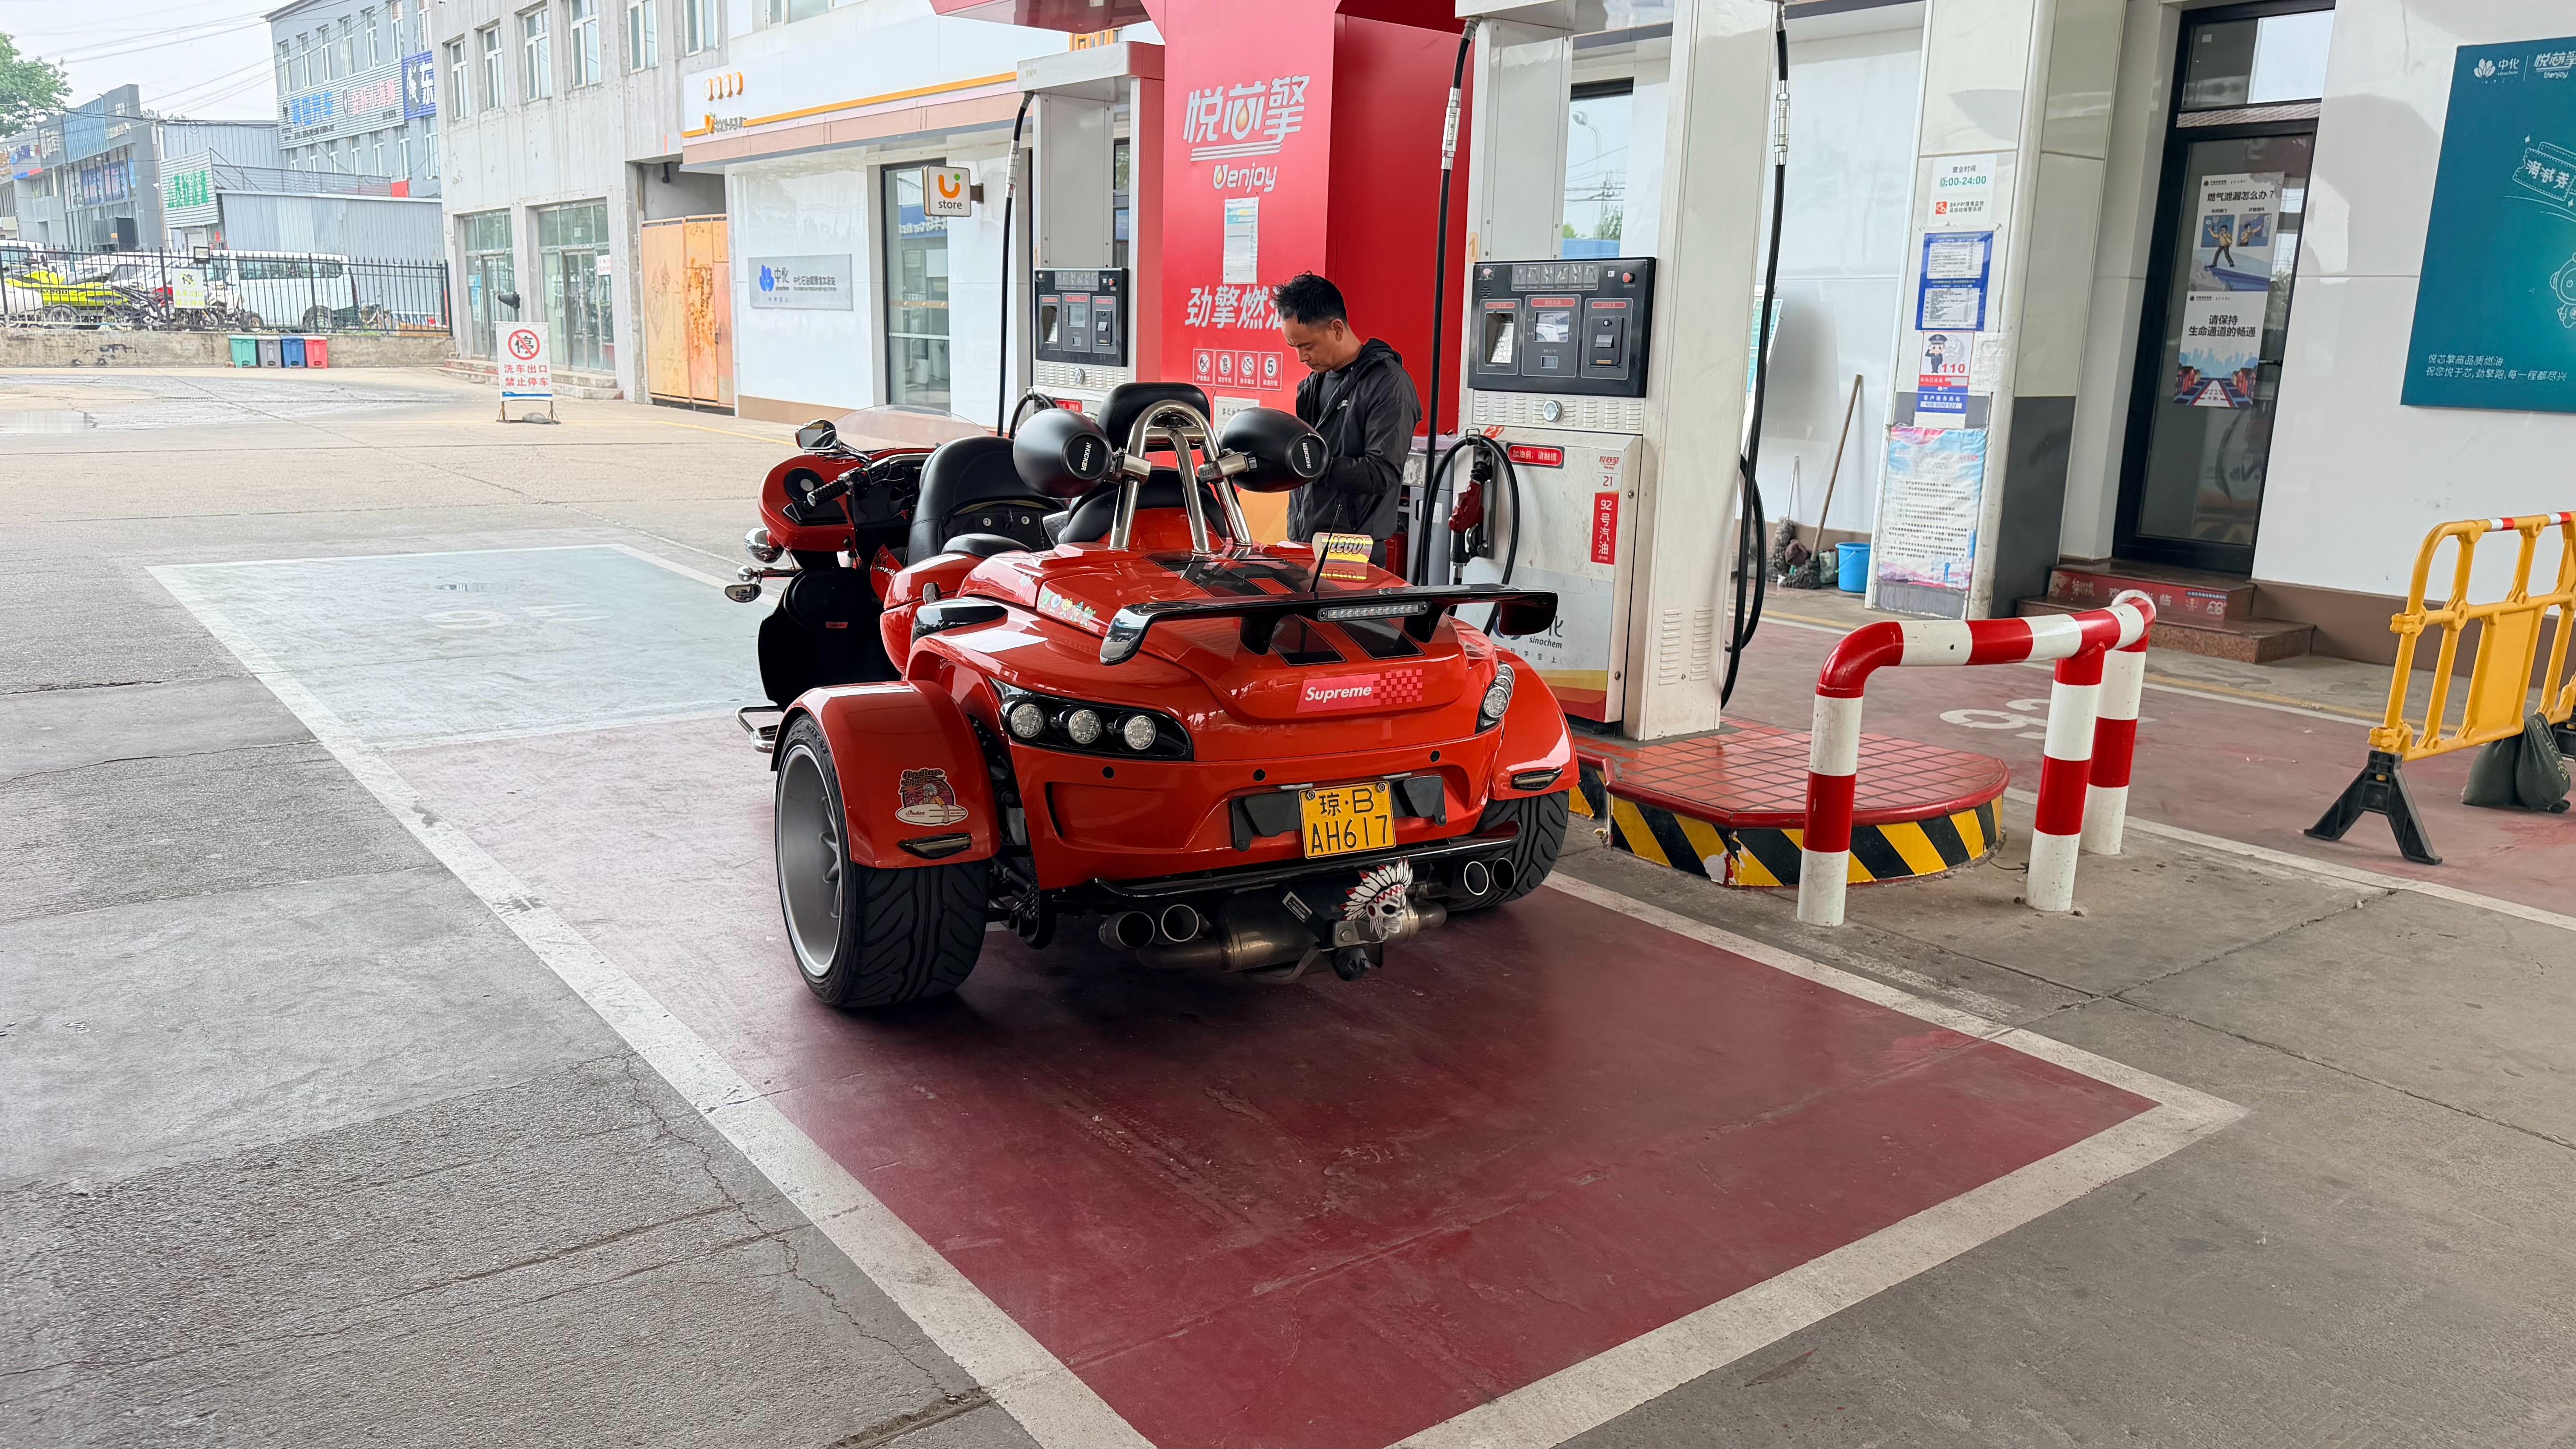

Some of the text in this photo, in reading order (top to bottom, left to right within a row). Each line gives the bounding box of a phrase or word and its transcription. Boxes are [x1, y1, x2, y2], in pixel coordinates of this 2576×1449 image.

[2498, 57, 2520, 70] 中化
[2544, 71, 2569, 79] Uenjoy
[1182, 75, 1310, 143] 悦芯擎
[1952, 165, 1976, 173] 营业时间
[2525, 158, 2570, 190] 满减券
[1213, 161, 1278, 193] Uenjoy
[938, 200, 962, 210] store
[774, 267, 789, 283] 中化
[2209, 314, 2238, 325] 请保持
[2188, 326, 2256, 337] 生命通道的畅通
[504, 364, 547, 373] 洗车出口
[1267, 360, 1274, 373] 5
[1942, 363, 1965, 373] 110
[505, 377, 549, 386] 禁止停车
[1485, 426, 1503, 437] 21
[1081, 447, 1090, 471] KICKER
[1302, 443, 1311, 465] KICKER
[1603, 476, 1613, 487] 21
[1329, 536, 1364, 554] LEGO
[1529, 636, 1562, 649] sinochem
[1305, 685, 1372, 704] Supreme
[1310, 814, 1389, 851] AH617
